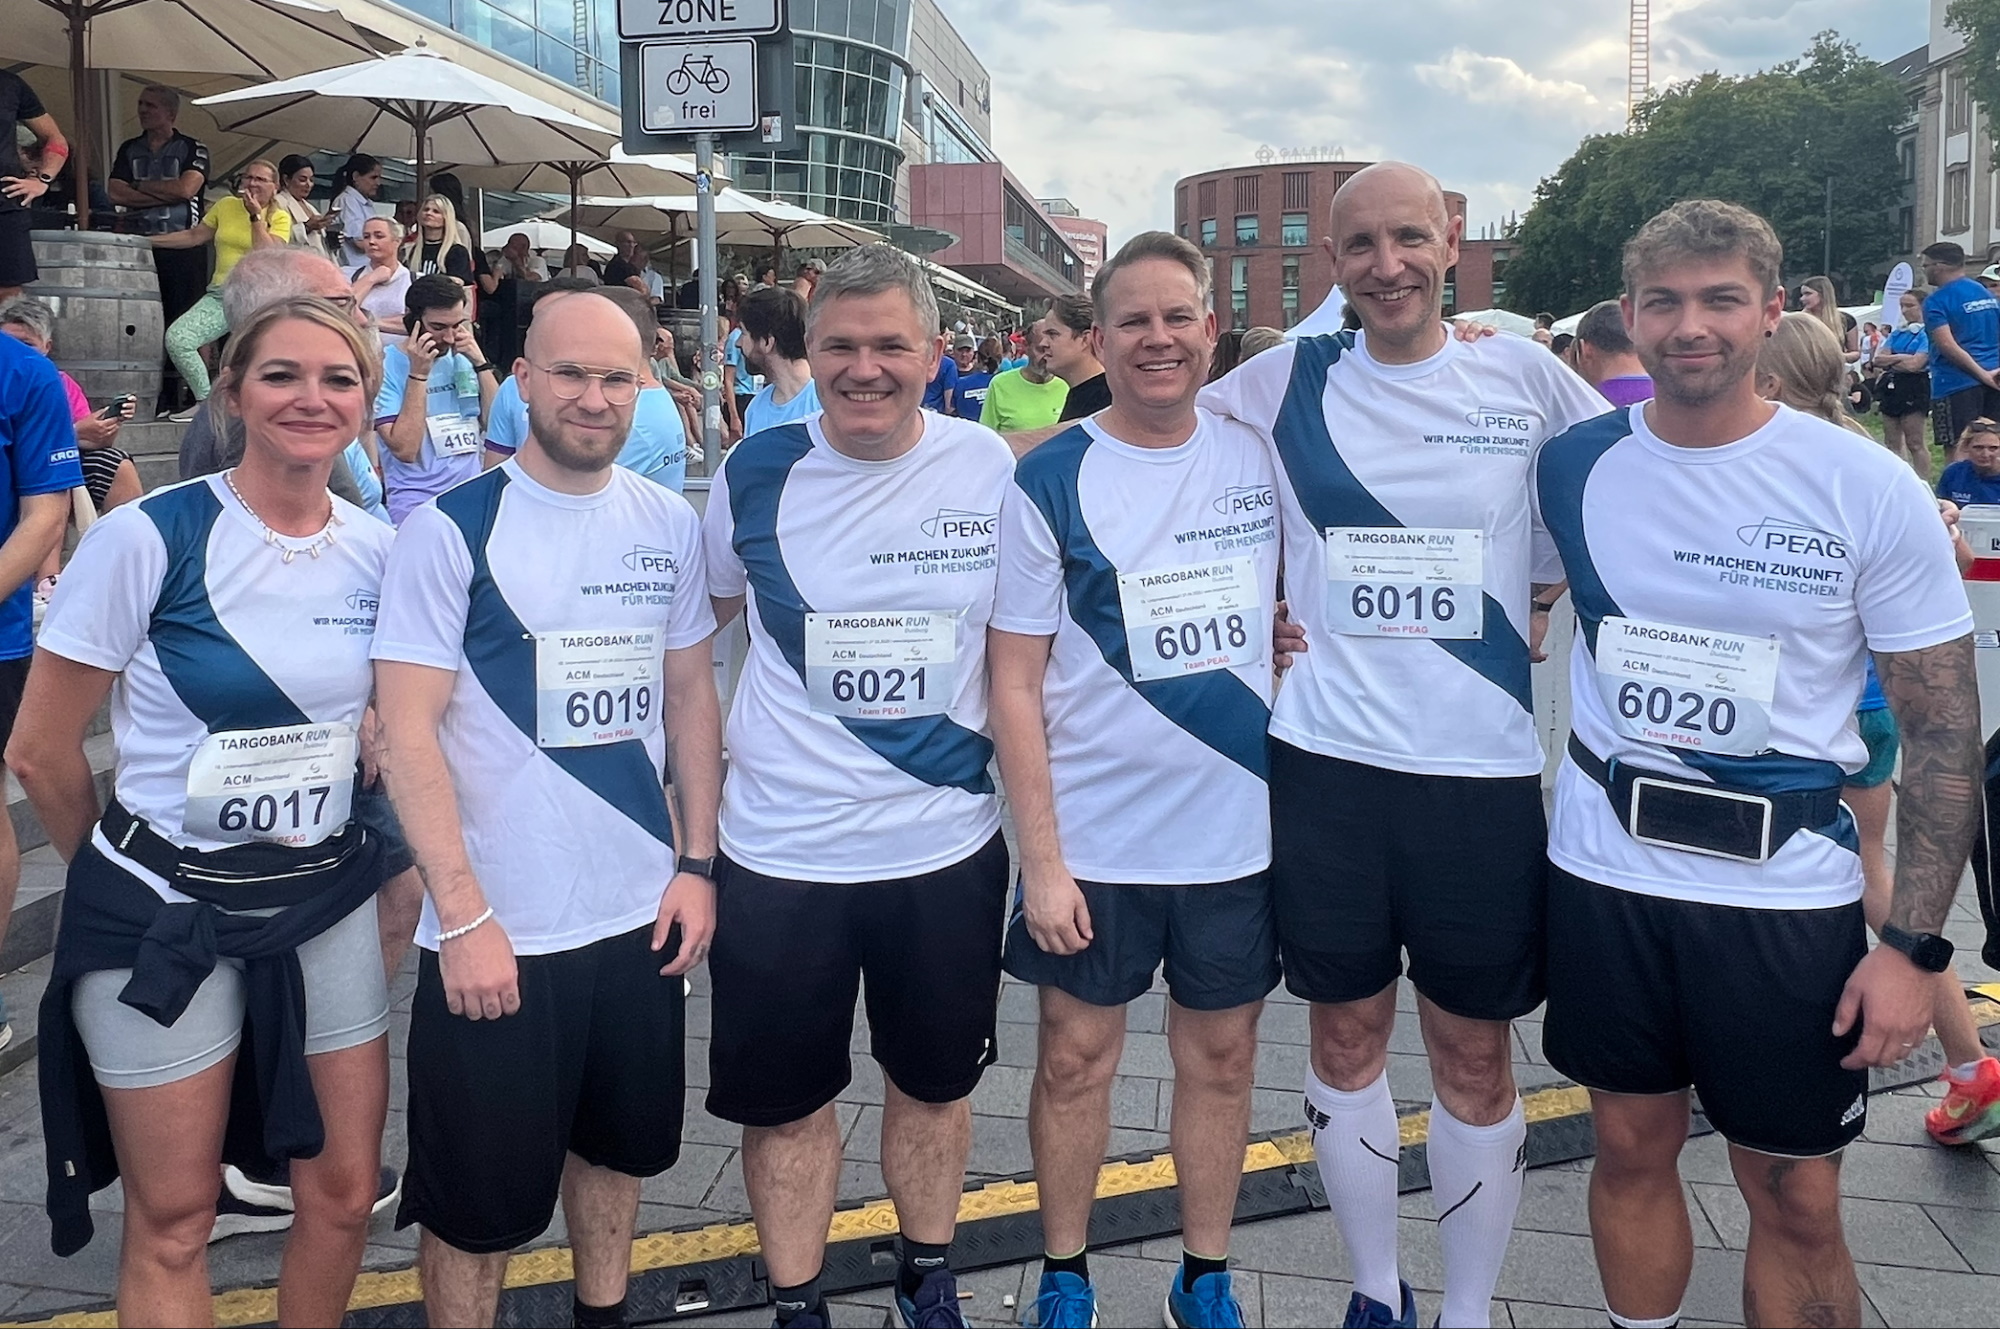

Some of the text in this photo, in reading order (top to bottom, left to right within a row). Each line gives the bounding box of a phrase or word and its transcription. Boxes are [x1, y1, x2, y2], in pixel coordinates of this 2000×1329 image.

[658, 0, 736, 25] ZONE
[682, 100, 716, 119] frei
[1280, 146, 1344, 157] GALERIA
[1484, 416, 1529, 431] PEAG
[444, 432, 477, 449] 4162
[1423, 434, 1444, 444] WIR
[1446, 435, 1490, 444] MACHEN
[1460, 444, 1481, 455] FÜR
[1233, 490, 1273, 514] PEAG
[943, 517, 997, 538] PEAG
[1174, 530, 1198, 544] WIR
[1198, 524, 1241, 541] MACHEN
[1214, 536, 1235, 551] FÜR
[1346, 533, 1455, 545] TARGOBANK RUN
[1765, 532, 1847, 559] PEAG
[870, 552, 895, 565] WIR
[897, 549, 949, 562] MACHEN
[914, 561, 939, 575] FÜR
[1351, 565, 1376, 574] ACM
[1673, 550, 1844, 583] WIR MACHEN ZUKUNFT.
[1139, 563, 1233, 588] TARGOBANK RUN
[1720, 570, 1748, 586] FÜR
[580, 585, 603, 595] WIR
[605, 581, 651, 594] MACHEN
[621, 592, 644, 606] FÜR
[1351, 584, 1455, 622] 6016
[1150, 605, 1174, 617] ACM
[313, 617, 330, 625] WIR
[332, 617, 364, 626] MACHEN
[827, 616, 931, 629] TARGOBANK RUN
[1376, 624, 1429, 634] Team PEAG
[560, 633, 653, 648] TARGOBANK RUN
[1154, 614, 1247, 660] 6018
[1622, 624, 1745, 653] TARGOBANK RUN
[832, 650, 856, 659] ACM
[1183, 655, 1230, 670] Team PEAG
[1622, 659, 1650, 673] ACM
[566, 670, 591, 680] ACM
[832, 666, 925, 703] 6021
[566, 686, 651, 728] 6019
[857, 706, 906, 715] Team PEAG
[1618, 681, 1736, 736] 6020
[219, 729, 331, 751] TARGOBANK RUN
[593, 728, 634, 740] Team PEAG
[1641, 727, 1702, 746] Team PEAG
[223, 774, 252, 786] ACM
[218, 785, 331, 832] 6017
[276, 834, 307, 844] PEAG
